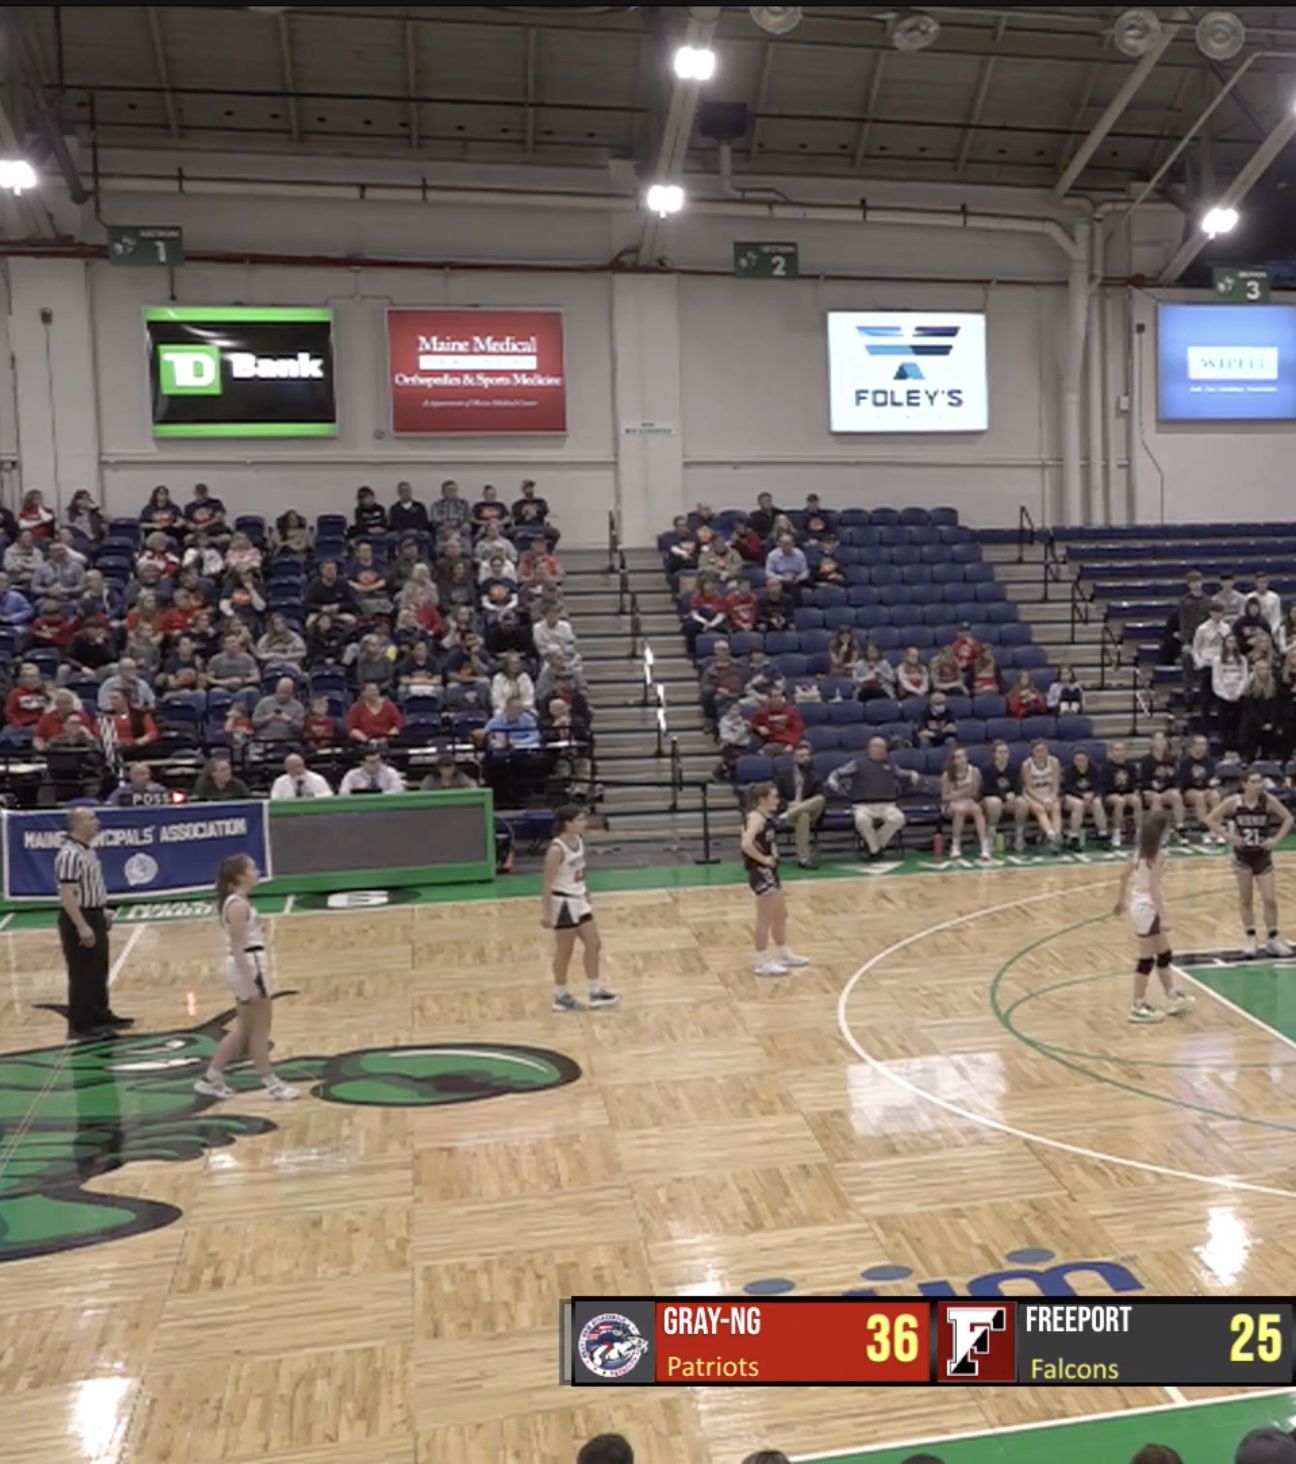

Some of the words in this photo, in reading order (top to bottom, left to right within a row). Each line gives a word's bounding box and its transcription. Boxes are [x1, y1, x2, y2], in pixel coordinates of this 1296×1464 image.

[155, 240, 167, 263] 1
[771, 254, 786, 276] 2
[1246, 279, 1260, 300] 3
[418, 335, 470, 353] Maine
[472, 335, 537, 354] Medical
[162, 352, 216, 387] TD
[227, 351, 324, 379] Bank
[394, 373, 461, 390] Orthopedics
[462, 374, 475, 387] &
[855, 389, 964, 407] FOLEY'S
[24, 830, 66, 849] MAINE
[160, 818, 247, 842] ASSOCIATION
[1242, 827, 1259, 847] 21
